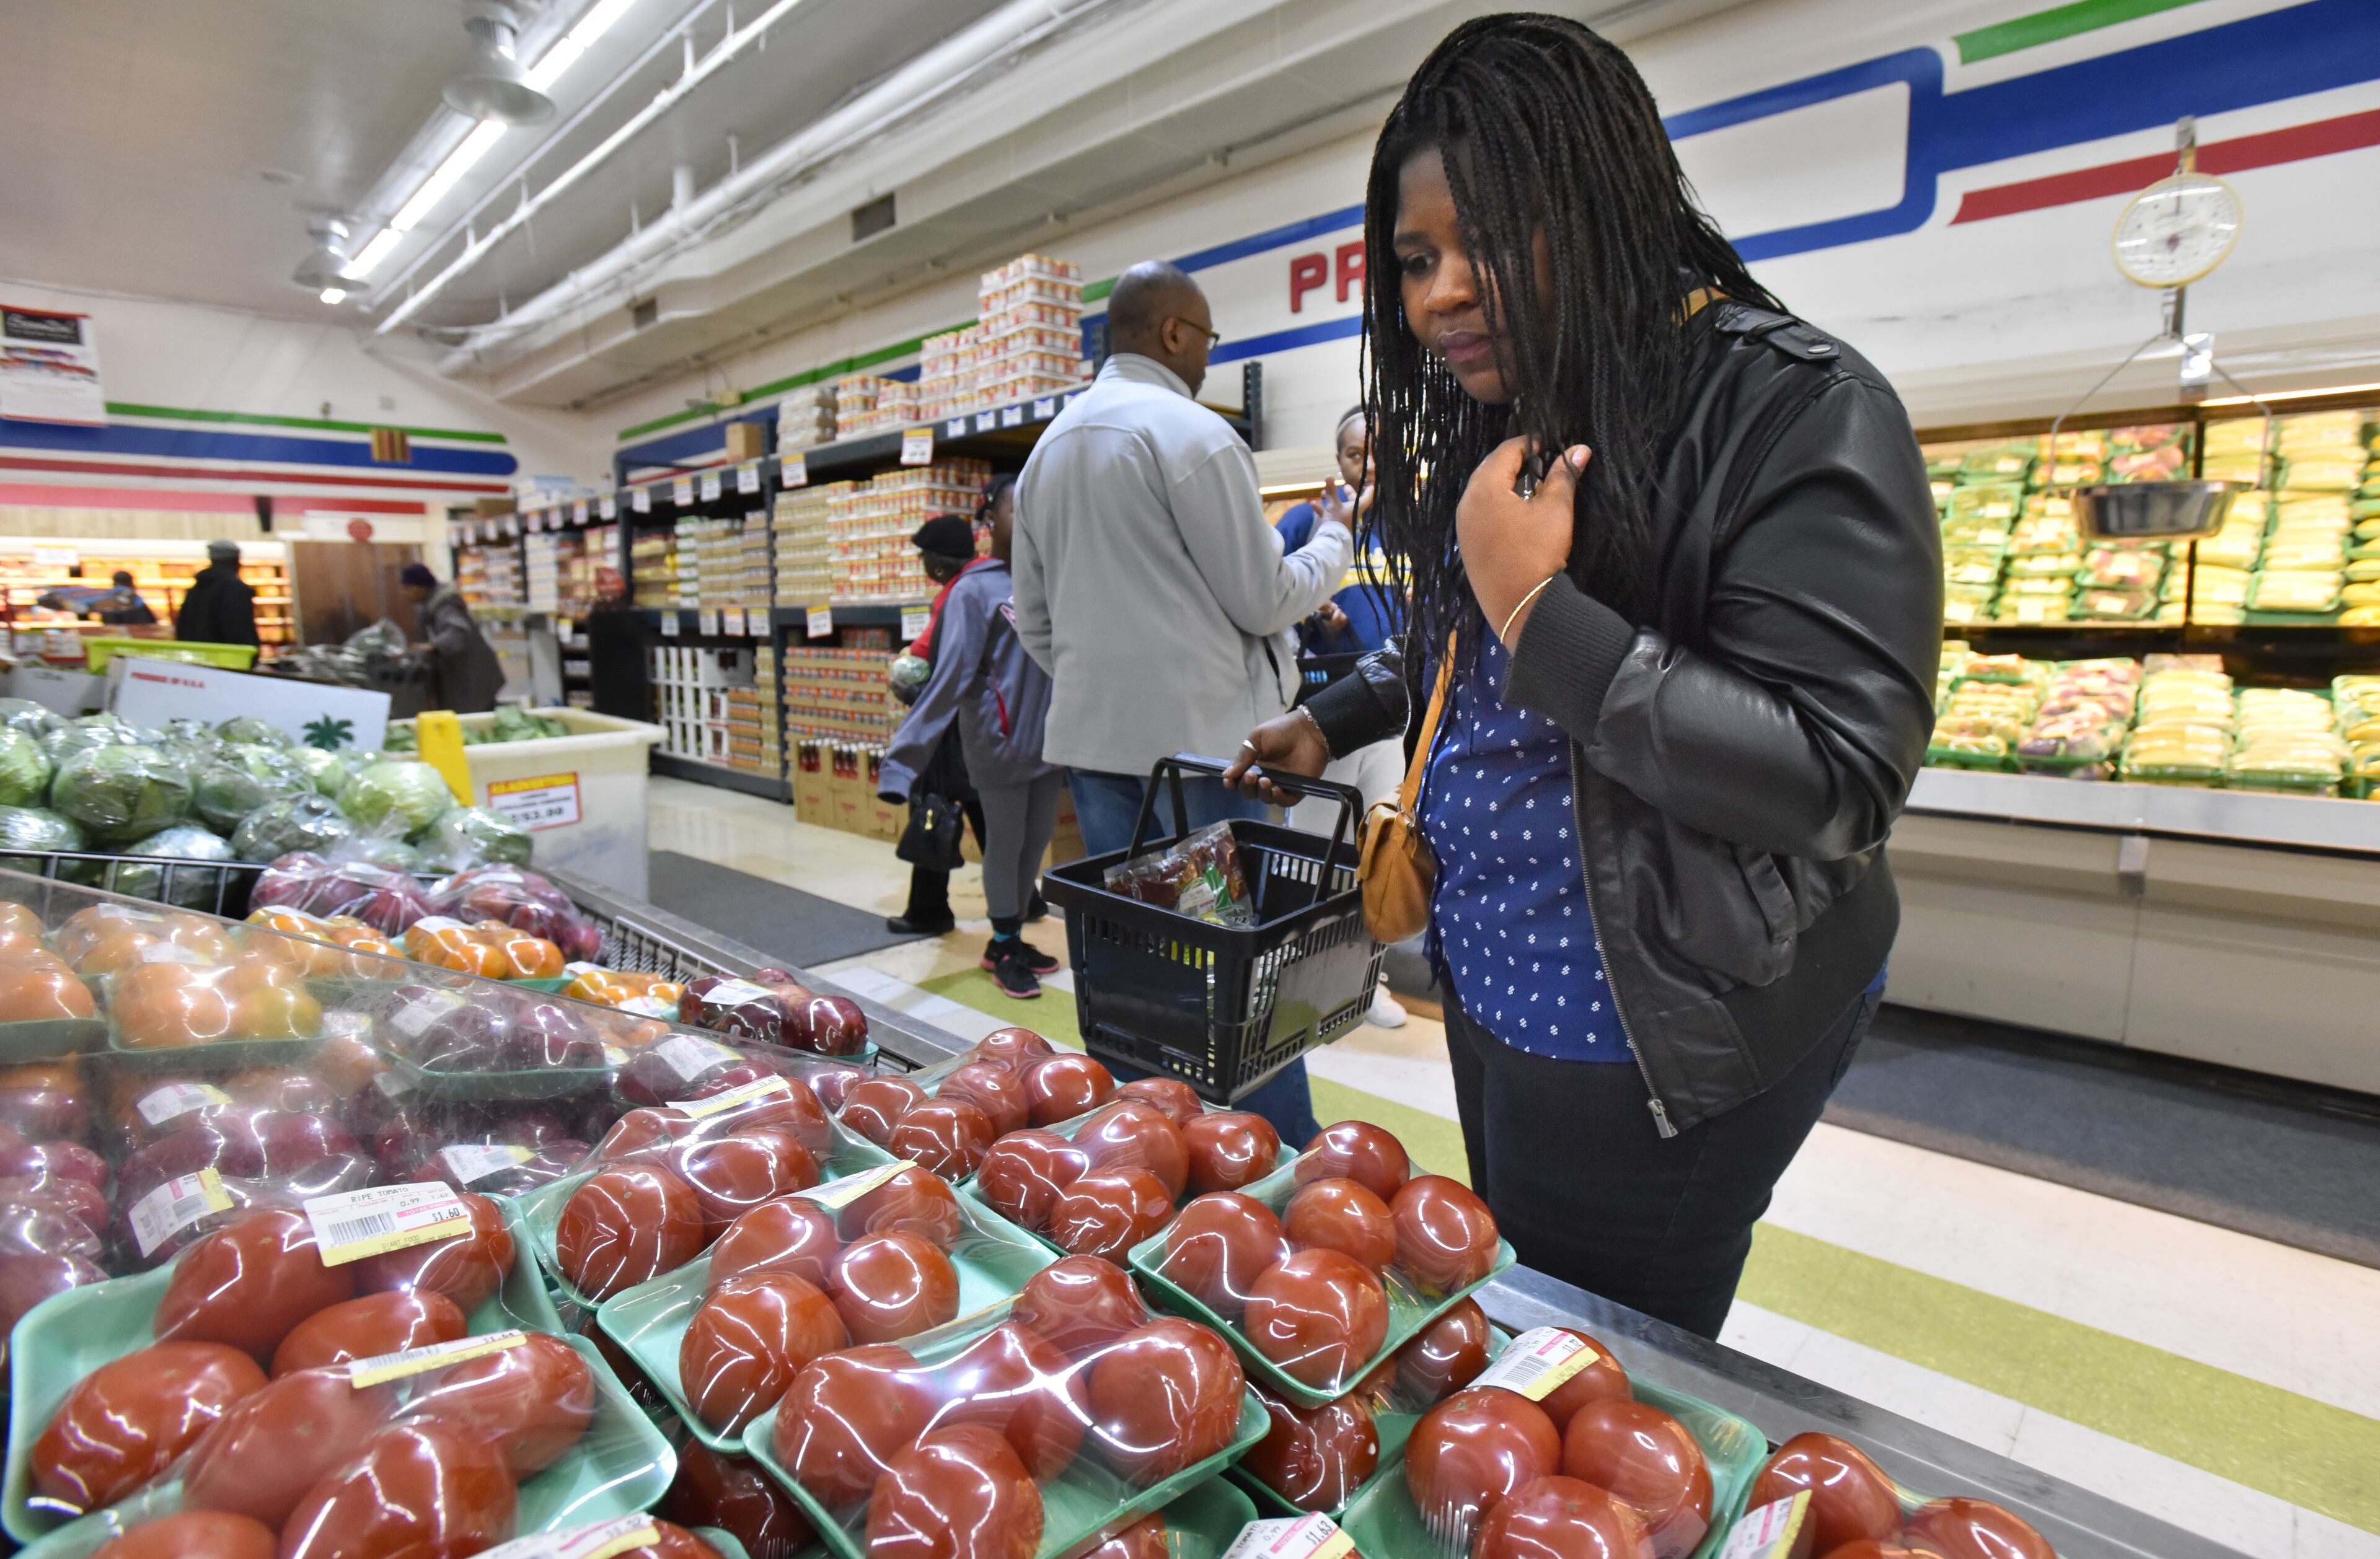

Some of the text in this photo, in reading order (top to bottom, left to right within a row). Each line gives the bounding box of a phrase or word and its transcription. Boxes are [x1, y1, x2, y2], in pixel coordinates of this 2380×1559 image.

[1290, 240, 1367, 315] PR
[350, 1193, 373, 1203] RIPE
[377, 1187, 409, 1197] TOMATO
[400, 1197, 420, 1207] 0.99
[405, 1205, 428, 1216] TOTAL
[432, 1207, 461, 1221] $1.60
[382, 1240, 402, 1249] GIANT
[404, 1234, 420, 1243] FOOD
[1562, 1338, 1582, 1353] $1.72
[1237, 1523, 1261, 1548] TOMATO
[1263, 1526, 1281, 1542] 0.99
[1305, 1519, 1333, 1545] $1.63
